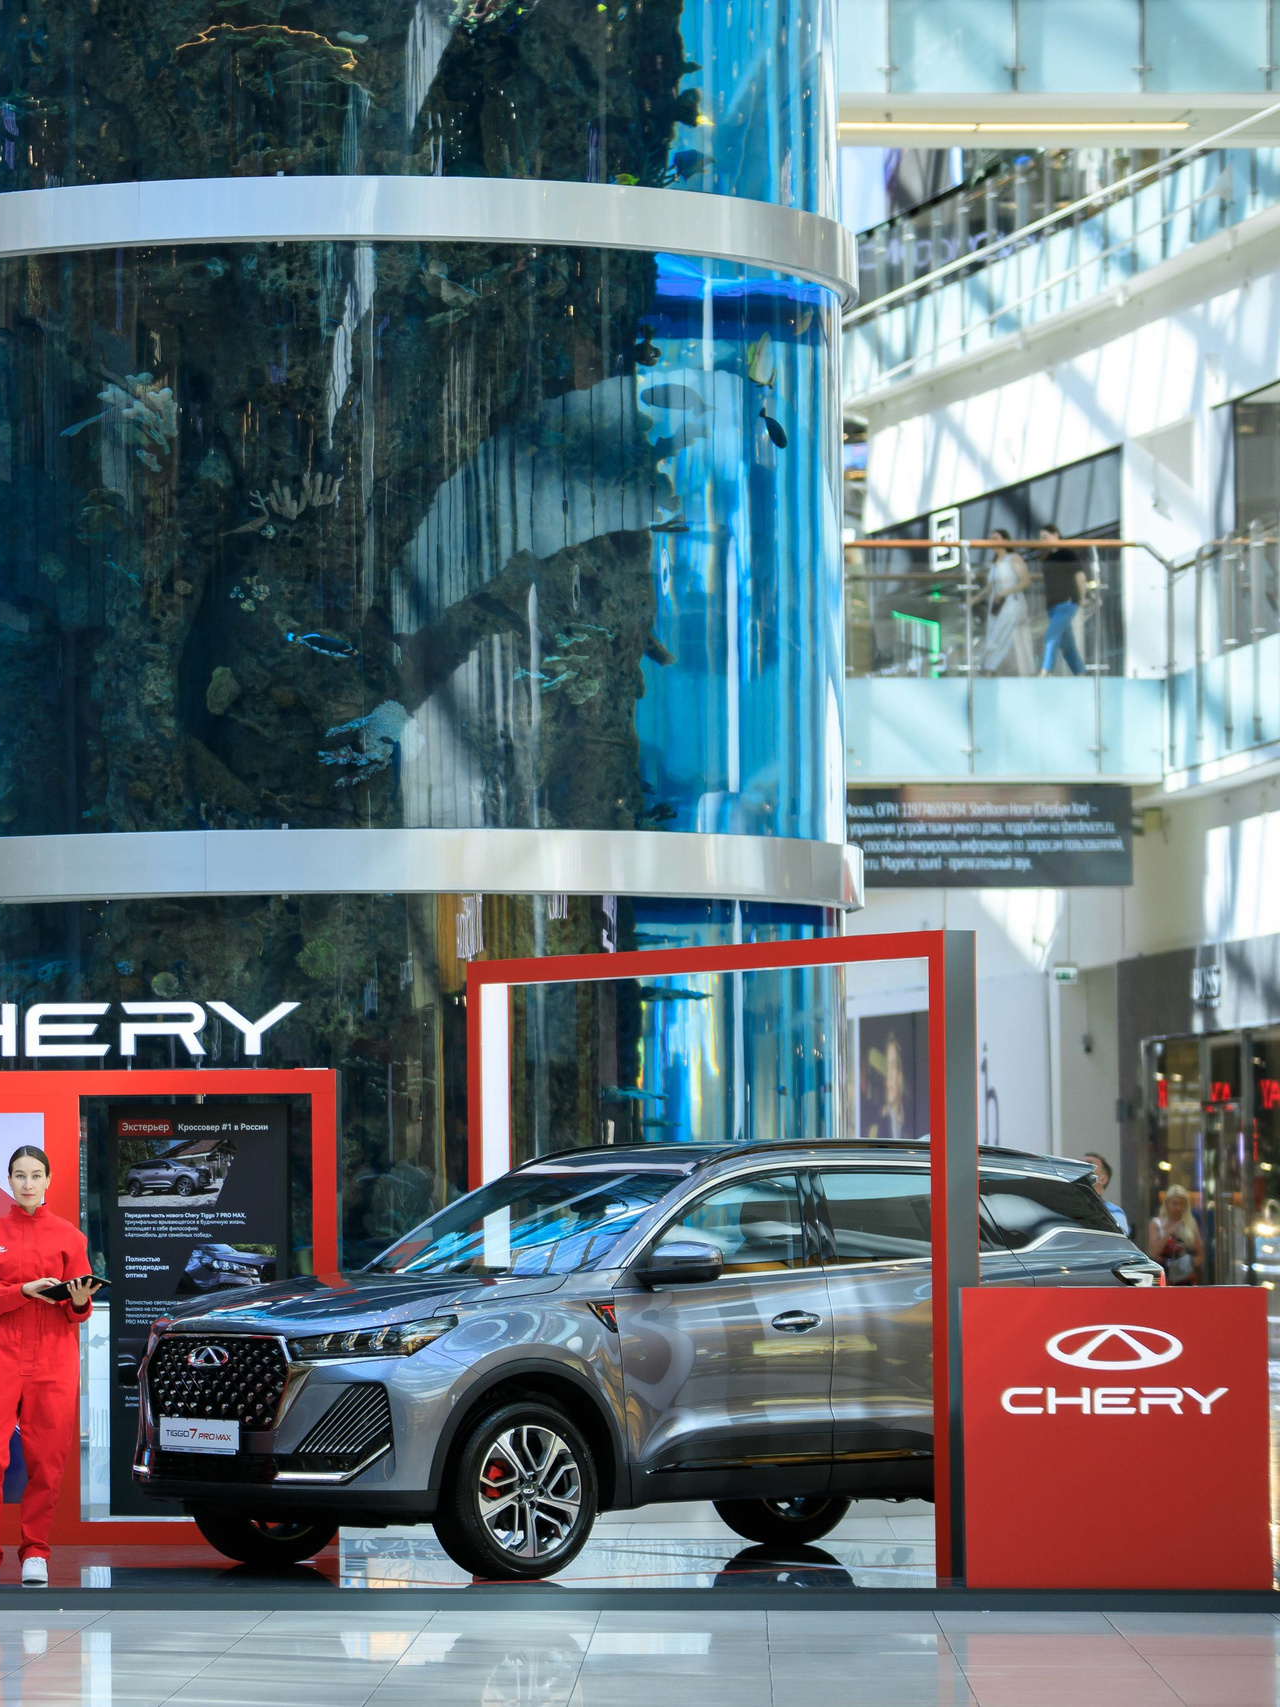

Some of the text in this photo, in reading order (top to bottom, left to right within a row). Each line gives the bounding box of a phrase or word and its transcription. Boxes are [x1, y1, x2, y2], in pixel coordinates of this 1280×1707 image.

[122, 1122, 170, 1133] Экстерьер
[178, 1123, 220, 1132] Кроссовер
[222, 1123, 232, 1131] #1
[240, 1122, 269, 1131] России
[125, 1255, 161, 1263] Полностью
[1000, 1385, 1230, 1416] CHERY
[165, 1428, 233, 1442] TIGGO 7 PRO MAX
